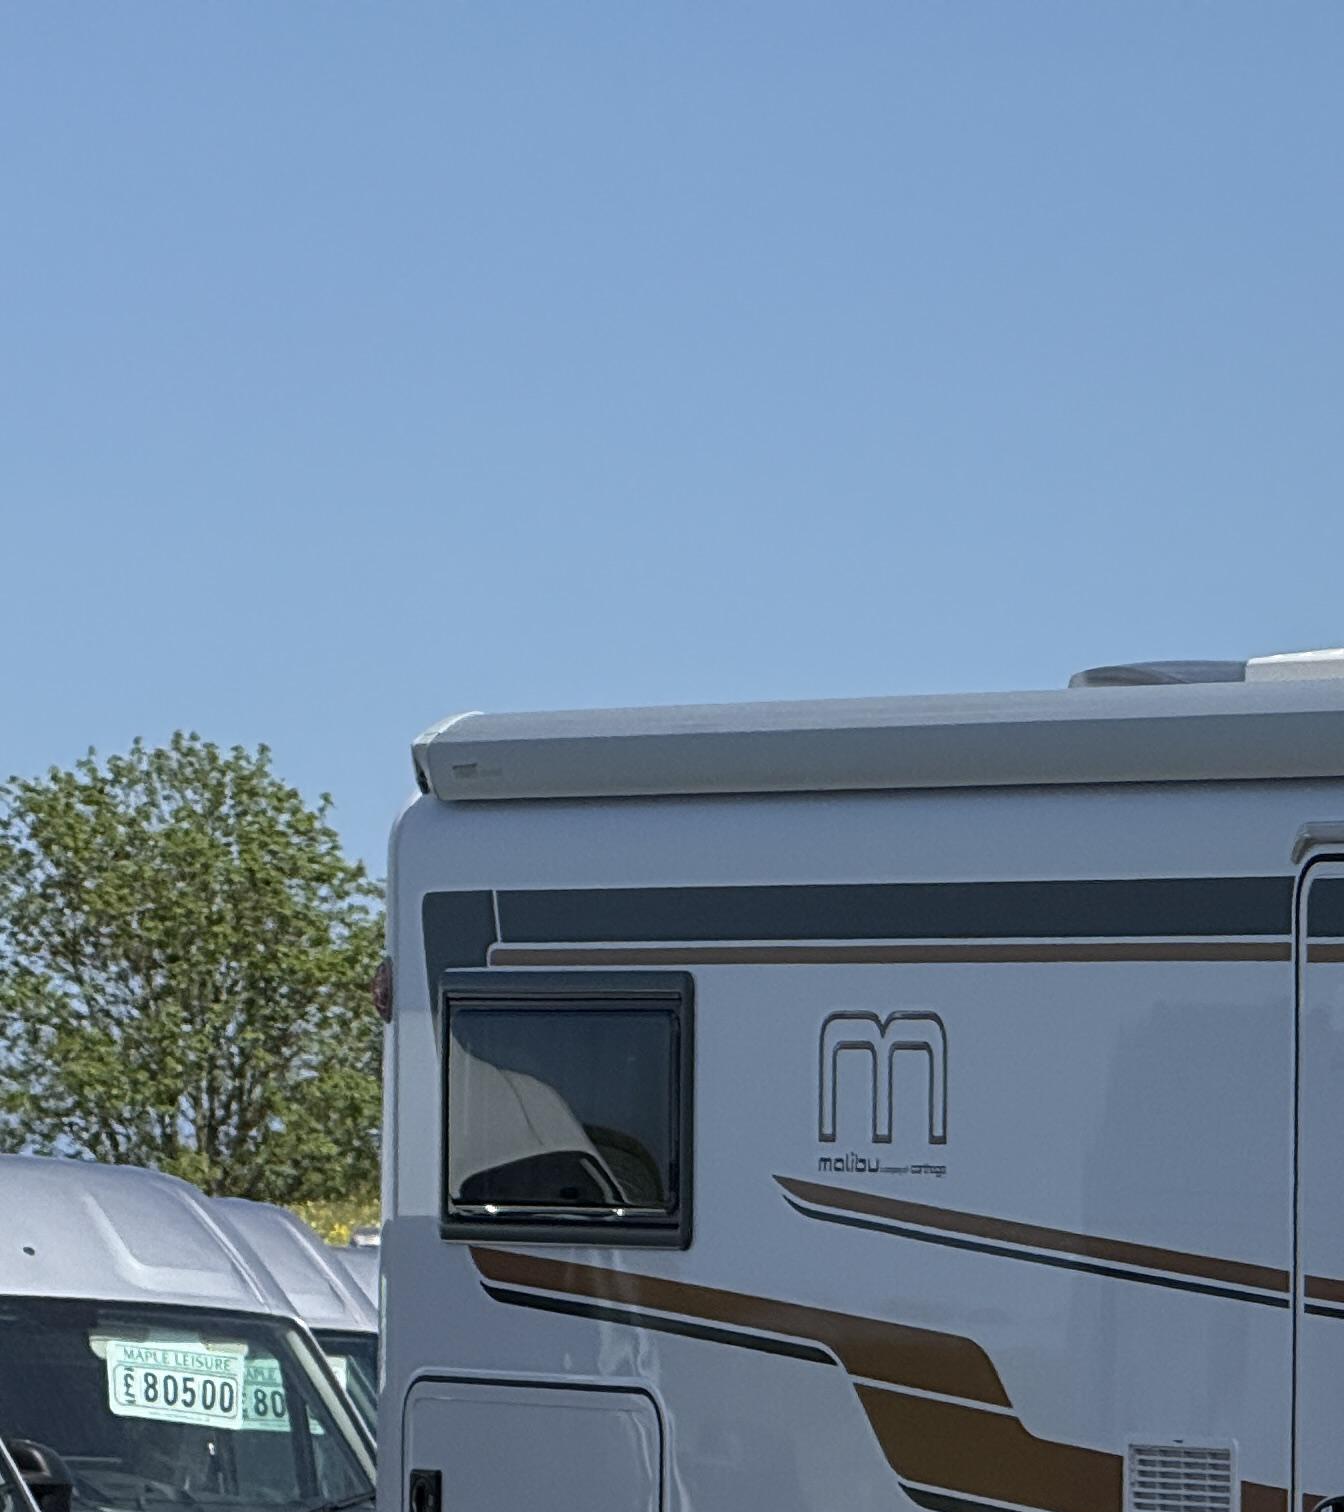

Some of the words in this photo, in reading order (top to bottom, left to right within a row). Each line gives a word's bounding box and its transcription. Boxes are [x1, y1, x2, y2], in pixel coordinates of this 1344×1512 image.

[818, 1152, 879, 1172] malibu
[124, 1347, 170, 1365] MAPLE
[174, 1352, 232, 1371] LEISURE
